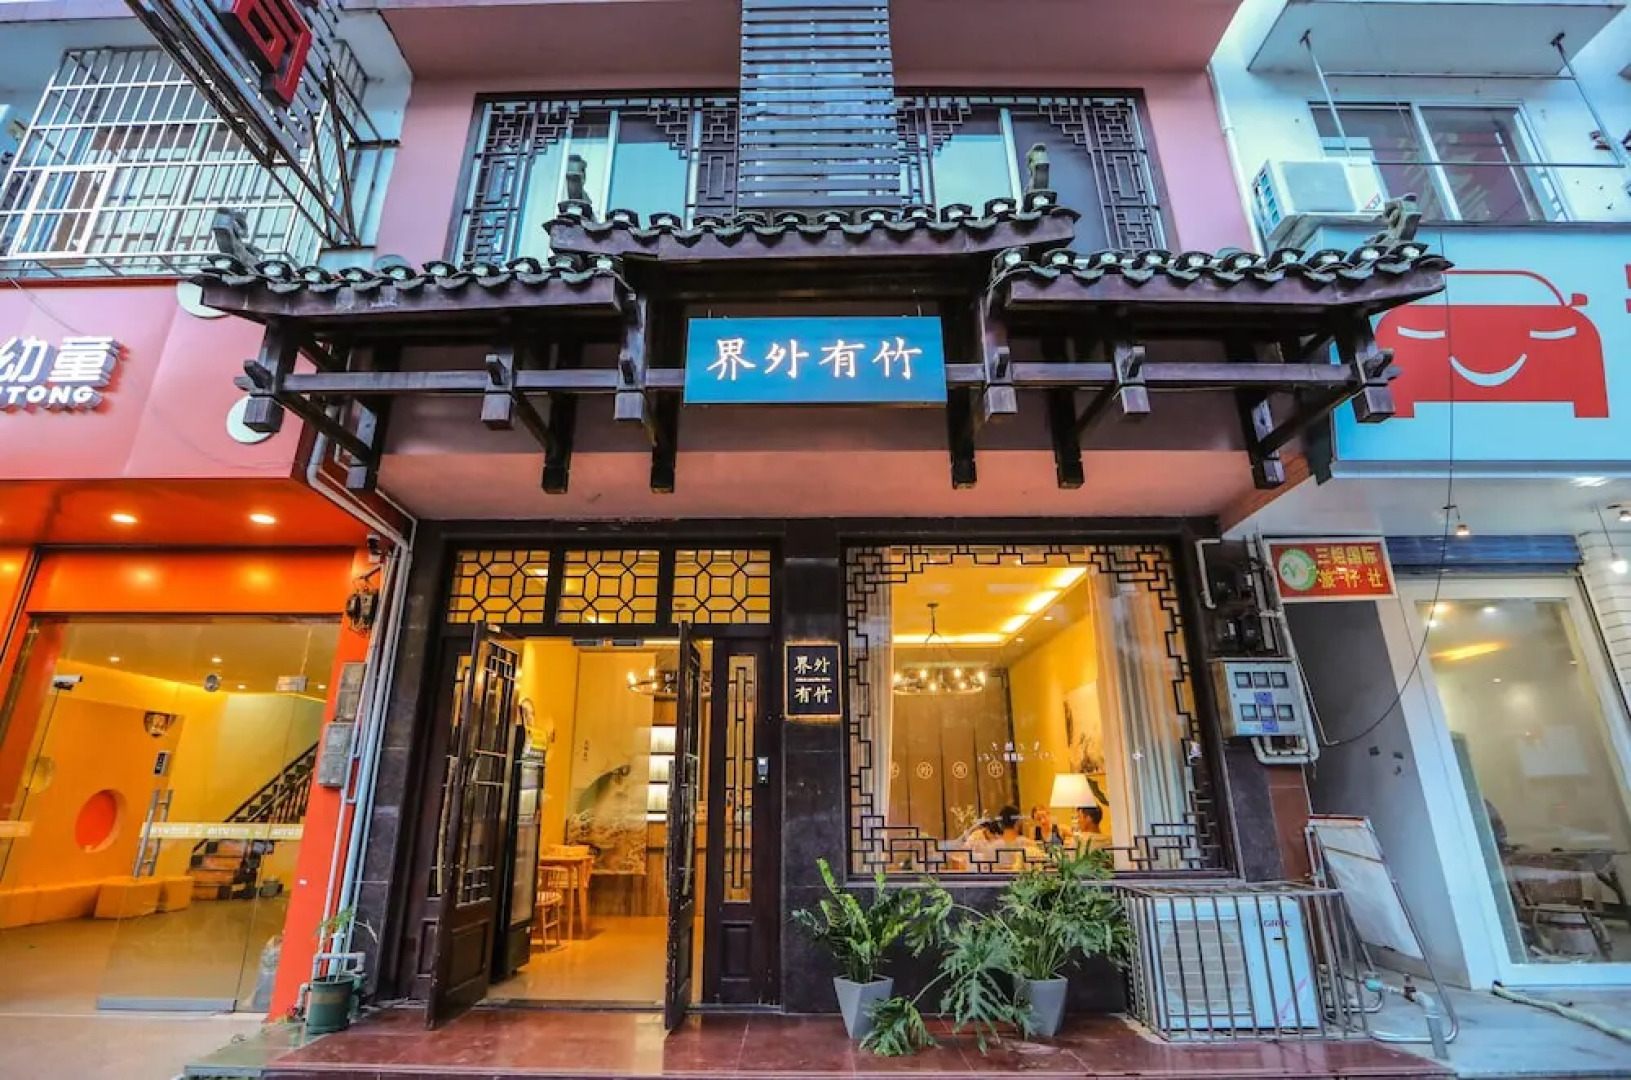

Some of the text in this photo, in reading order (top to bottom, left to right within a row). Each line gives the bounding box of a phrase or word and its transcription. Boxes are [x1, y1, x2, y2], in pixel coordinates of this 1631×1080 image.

[0, 336, 113, 382] 幼童
[707, 337, 923, 381] 界外有竹
[0, 385, 94, 404] TONG
[794, 656, 831, 675] 界外
[794, 685, 832, 704] 有竹
